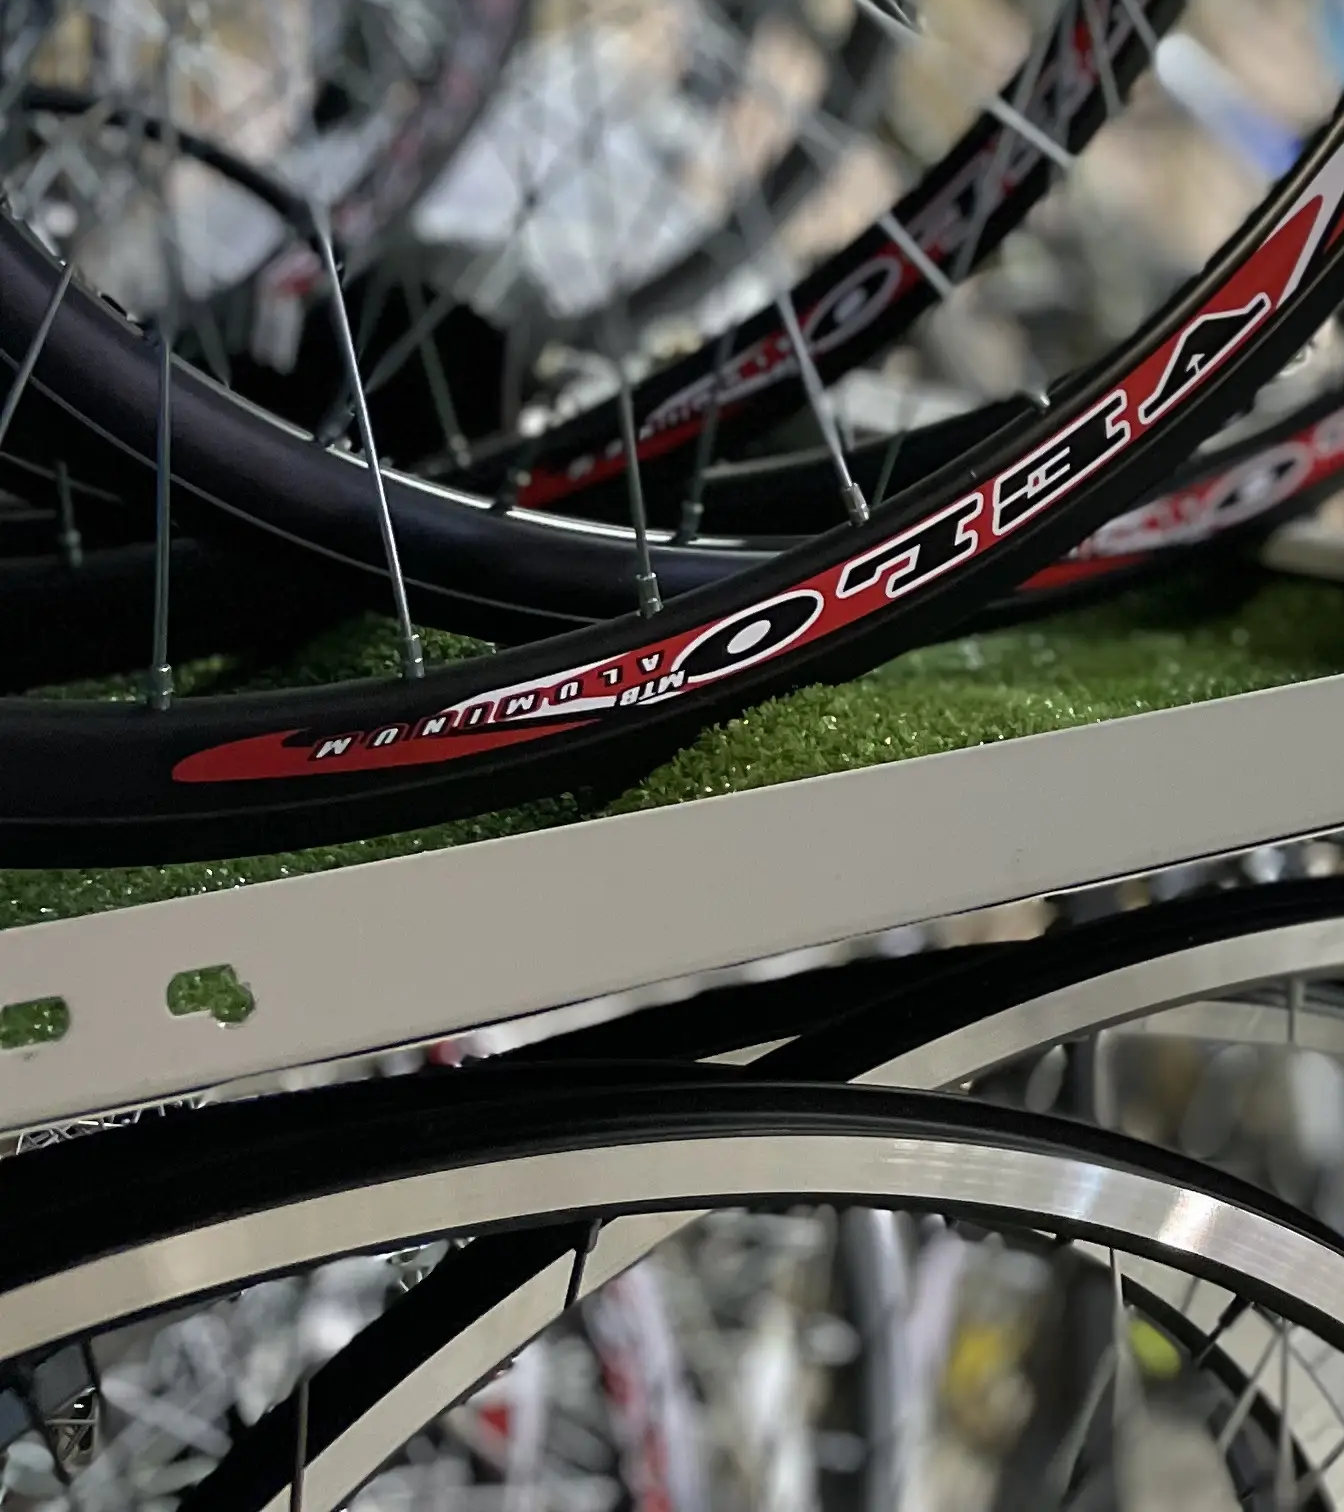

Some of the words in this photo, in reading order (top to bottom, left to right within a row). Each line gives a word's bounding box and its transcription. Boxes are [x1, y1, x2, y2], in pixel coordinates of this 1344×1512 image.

[671, 292, 1231, 682] VELO
[314, 652, 663, 760] ALUMINUM
[620, 669, 686, 709] MTB
